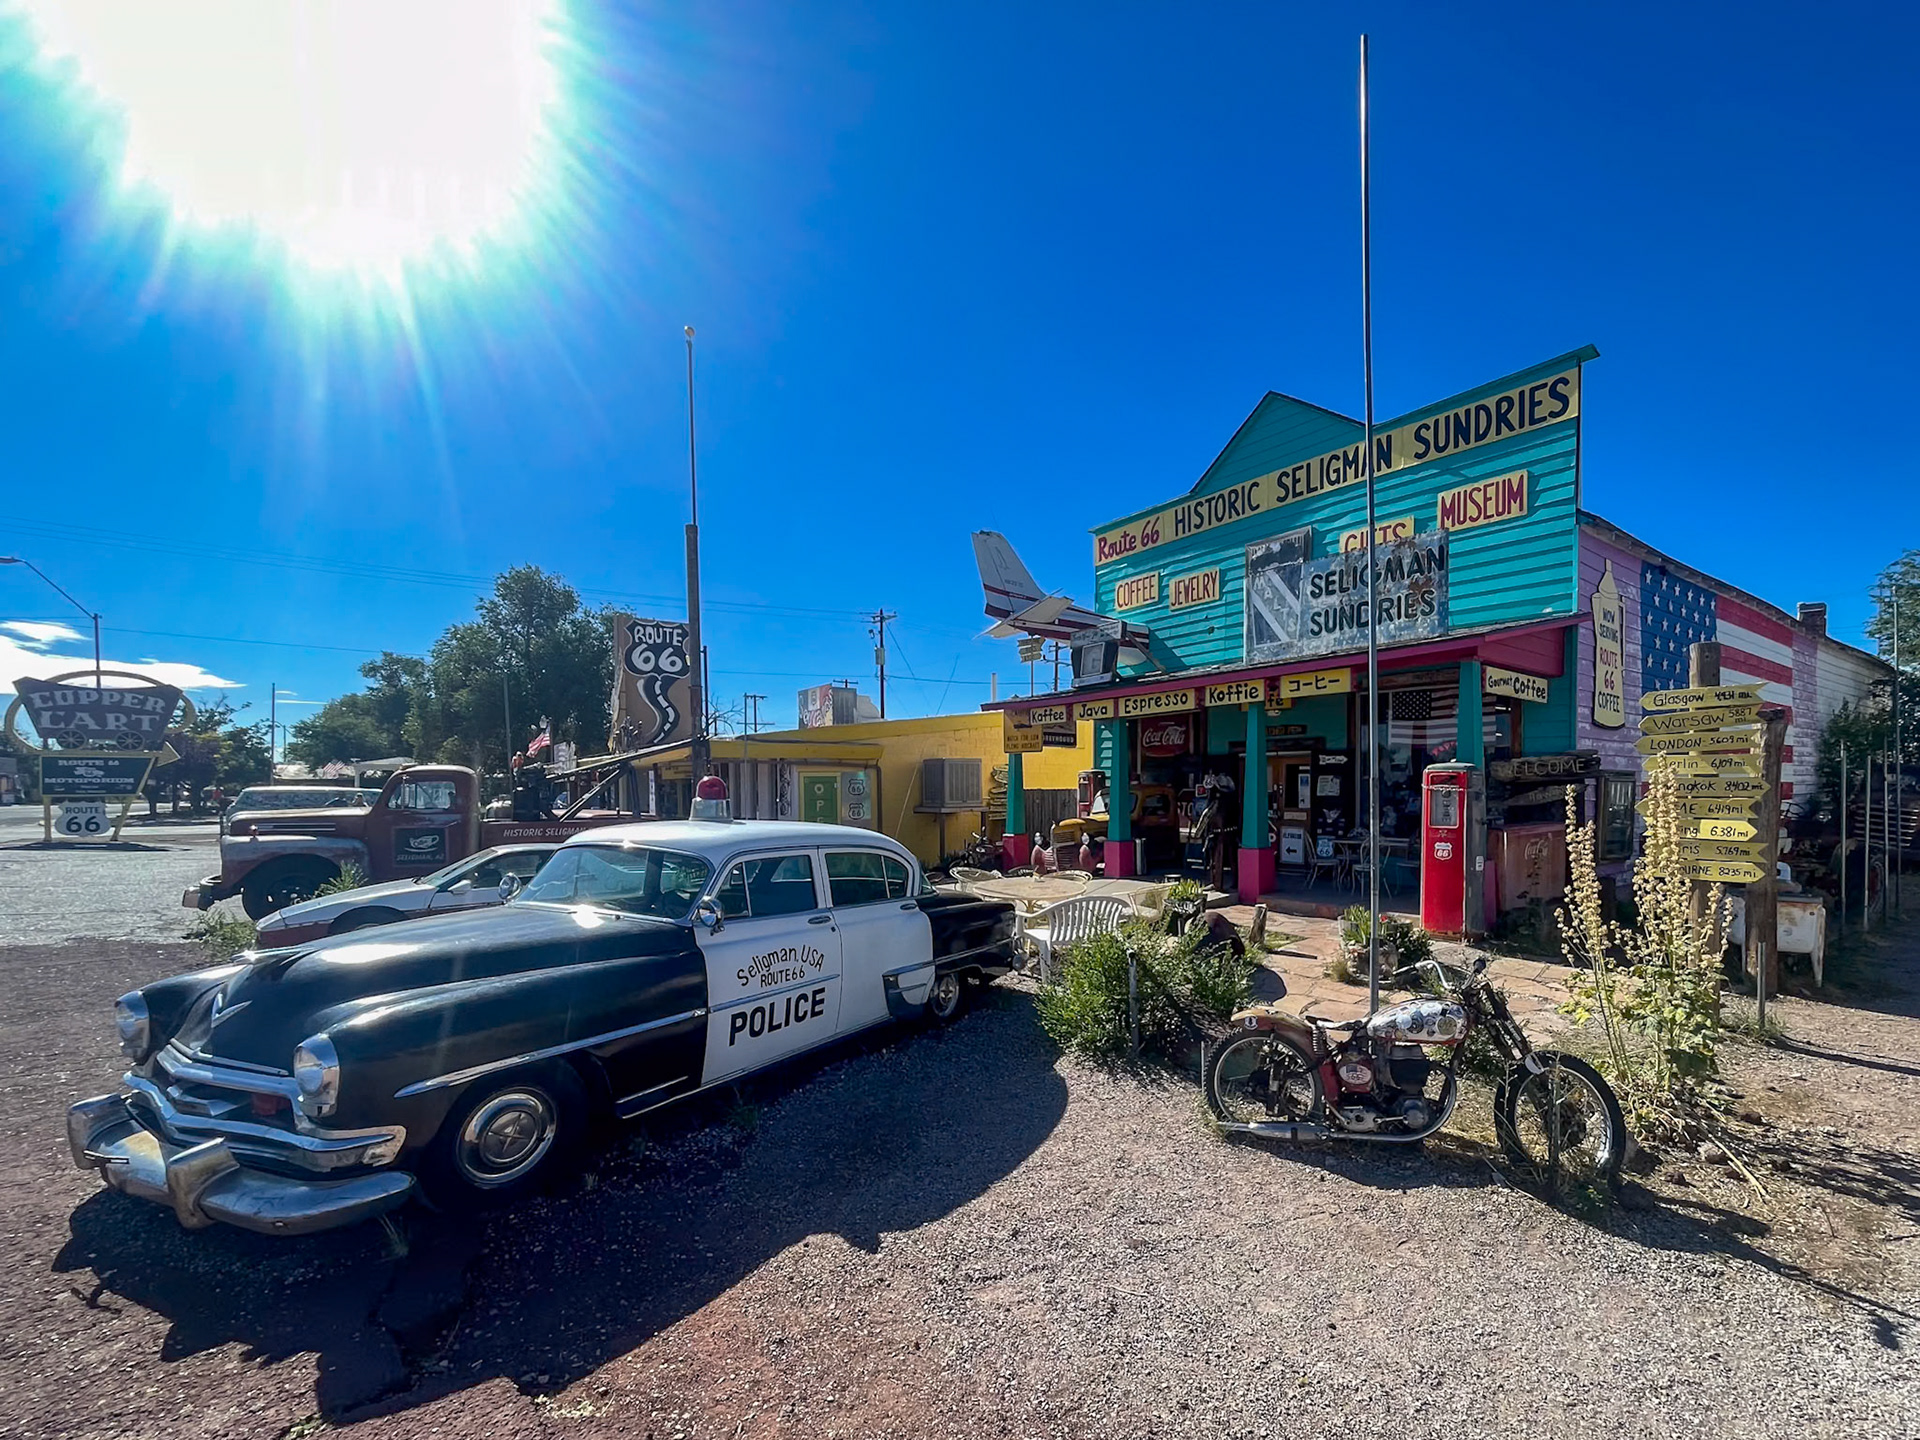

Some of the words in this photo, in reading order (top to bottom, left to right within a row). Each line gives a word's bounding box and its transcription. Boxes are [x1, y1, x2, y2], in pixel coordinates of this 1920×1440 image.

[1097, 530, 1137, 562] Route
[1140, 516, 1160, 547] 66
[1175, 482, 1261, 537] HISTORIC
[1413, 377, 1571, 460] SUNDRIES
[1440, 474, 1525, 529] MUSEUM
[1310, 545, 1446, 600] SELIGMAN
[1116, 574, 1156, 608] COFFEE
[1171, 570, 1218, 606] JEWELRY
[1254, 572, 1297, 632] MALTS
[1310, 588, 1437, 637] SUNDRIES
[1602, 607, 1616, 624] NOW
[633, 625, 682, 646] ROUTE
[1599, 623, 1619, 644] SERVING
[631, 643, 683, 673] 66
[1600, 647, 1618, 669] ROUTE
[1288, 675, 1341, 692] コーヒー
[1513, 677, 1546, 699] Coffee
[1604, 670, 1615, 691] 66
[29, 690, 166, 714] COPPER
[1124, 693, 1188, 714] Espresso
[1209, 683, 1259, 703] Koffie
[1597, 690, 1620, 713] COFFEE
[1653, 693, 1705, 706] Glasgow
[1031, 708, 1064, 723] Kaffee
[1079, 703, 1108, 717] Java
[1652, 713, 1725, 731] Warsaw
[1728, 707, 1752, 718] 5887
[38, 711, 161, 731] CART
[1650, 737, 1702, 750] LONDON
[1669, 757, 1698, 769] erlin
[1677, 780, 1717, 794] ngkok
[65, 806, 100, 814] ROUTE
[66, 816, 100, 833] 66
[503, 828, 543, 837] HISTORIC
[1737, 830, 1749, 838] mi
[1437, 849, 1449, 857] 66
[1682, 842, 1700, 855] ris
[801, 944, 825, 972] USA
[760, 968, 791, 988] ROUTE
[791, 965, 805, 981] 66
[729, 987, 826, 1047] POLICE
